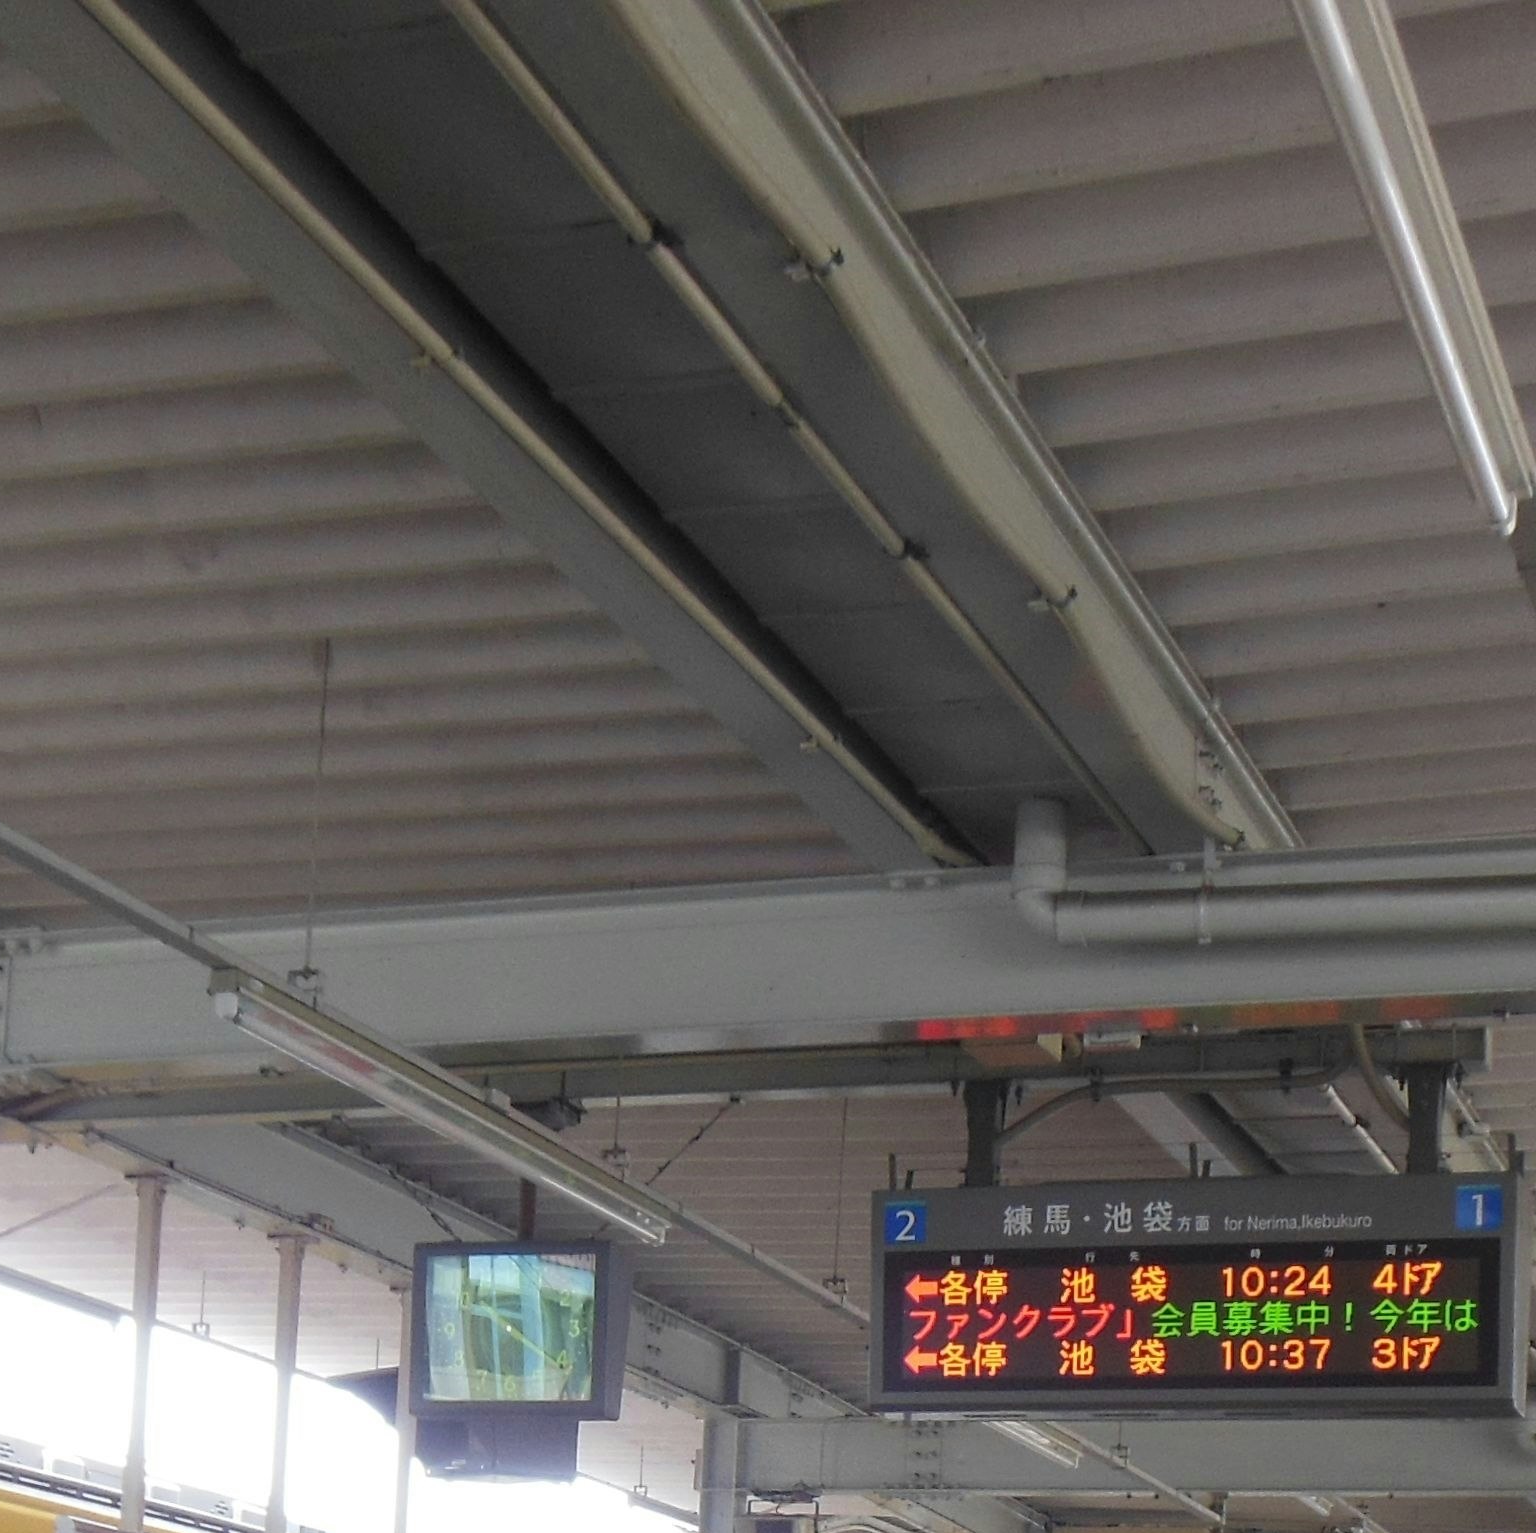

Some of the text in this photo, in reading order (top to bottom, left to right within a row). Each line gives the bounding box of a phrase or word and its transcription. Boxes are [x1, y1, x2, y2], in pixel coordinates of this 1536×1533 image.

[895, 1210, 917, 1242] 2
[1224, 1215, 1243, 1231] for
[1472, 1194, 1484, 1226] 1
[939, 1269, 1008, 1305] 各停
[1222, 1264, 1332, 1297] 10:24
[938, 1340, 1007, 1377] 各停
[1221, 1338, 1331, 1371] 10:37
